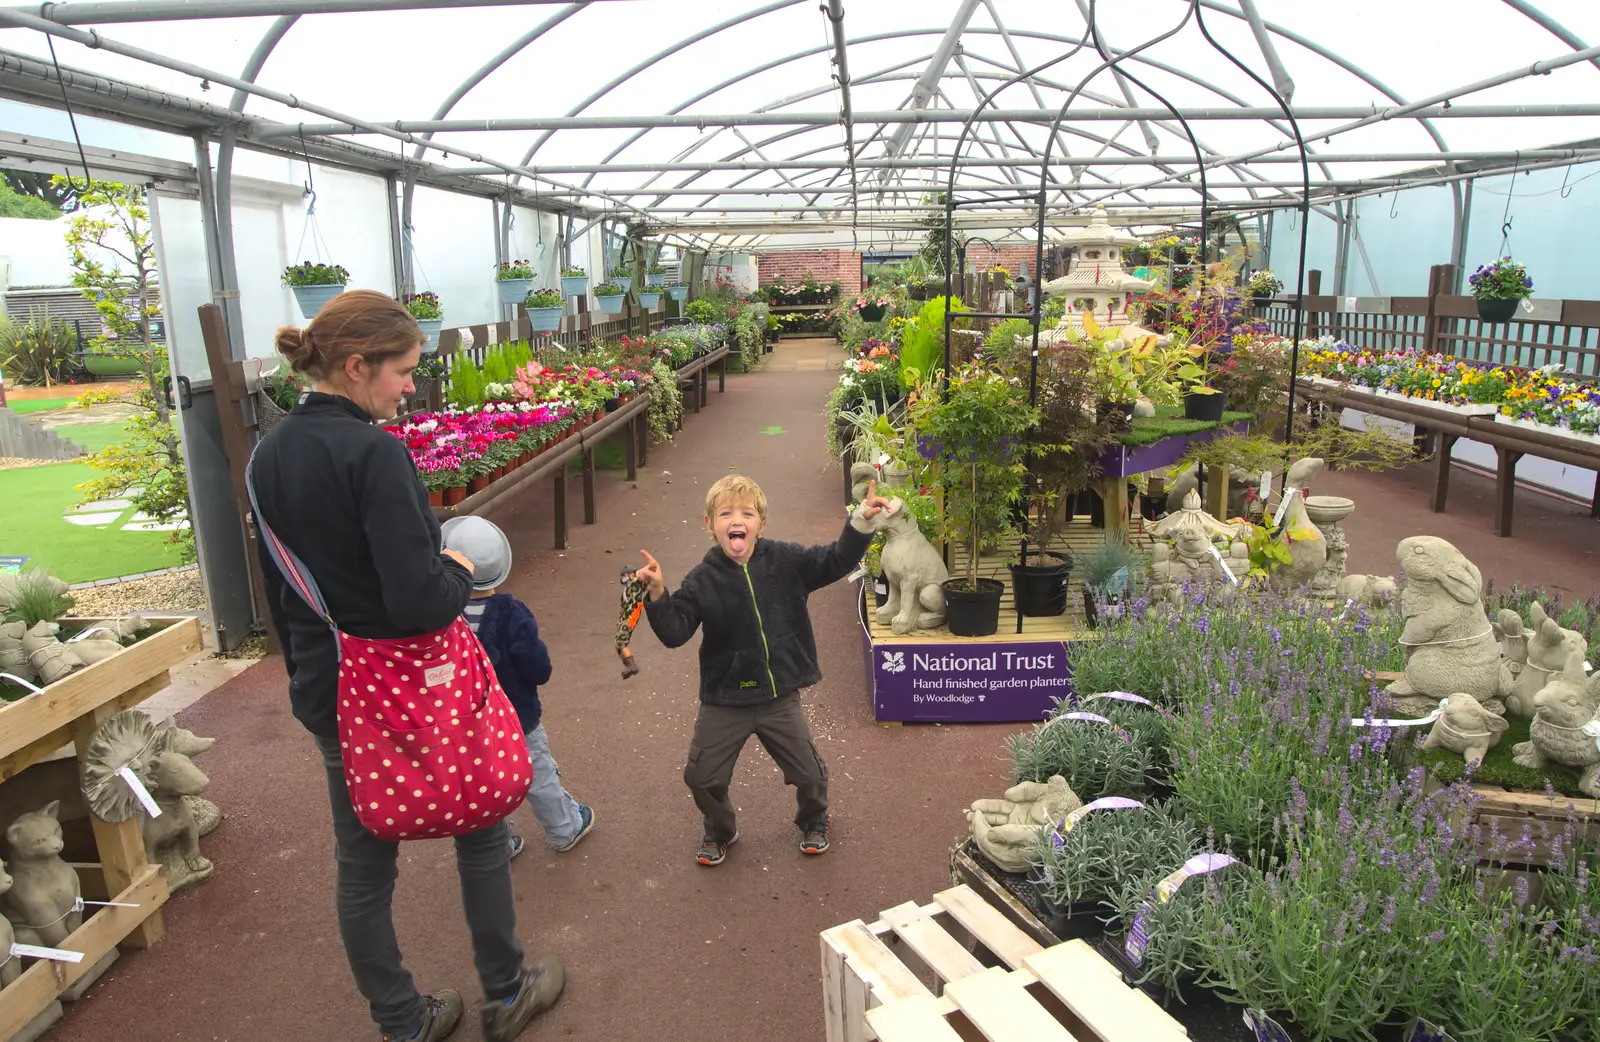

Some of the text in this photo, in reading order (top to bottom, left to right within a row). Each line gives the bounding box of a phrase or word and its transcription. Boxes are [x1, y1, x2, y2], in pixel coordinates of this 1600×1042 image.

[913, 651, 1055, 672] National Trust
[913, 678, 943, 689] Hand
[945, 677, 987, 689] finished
[989, 677, 1028, 691] garden
[913, 693, 975, 704] By Woodlodge
